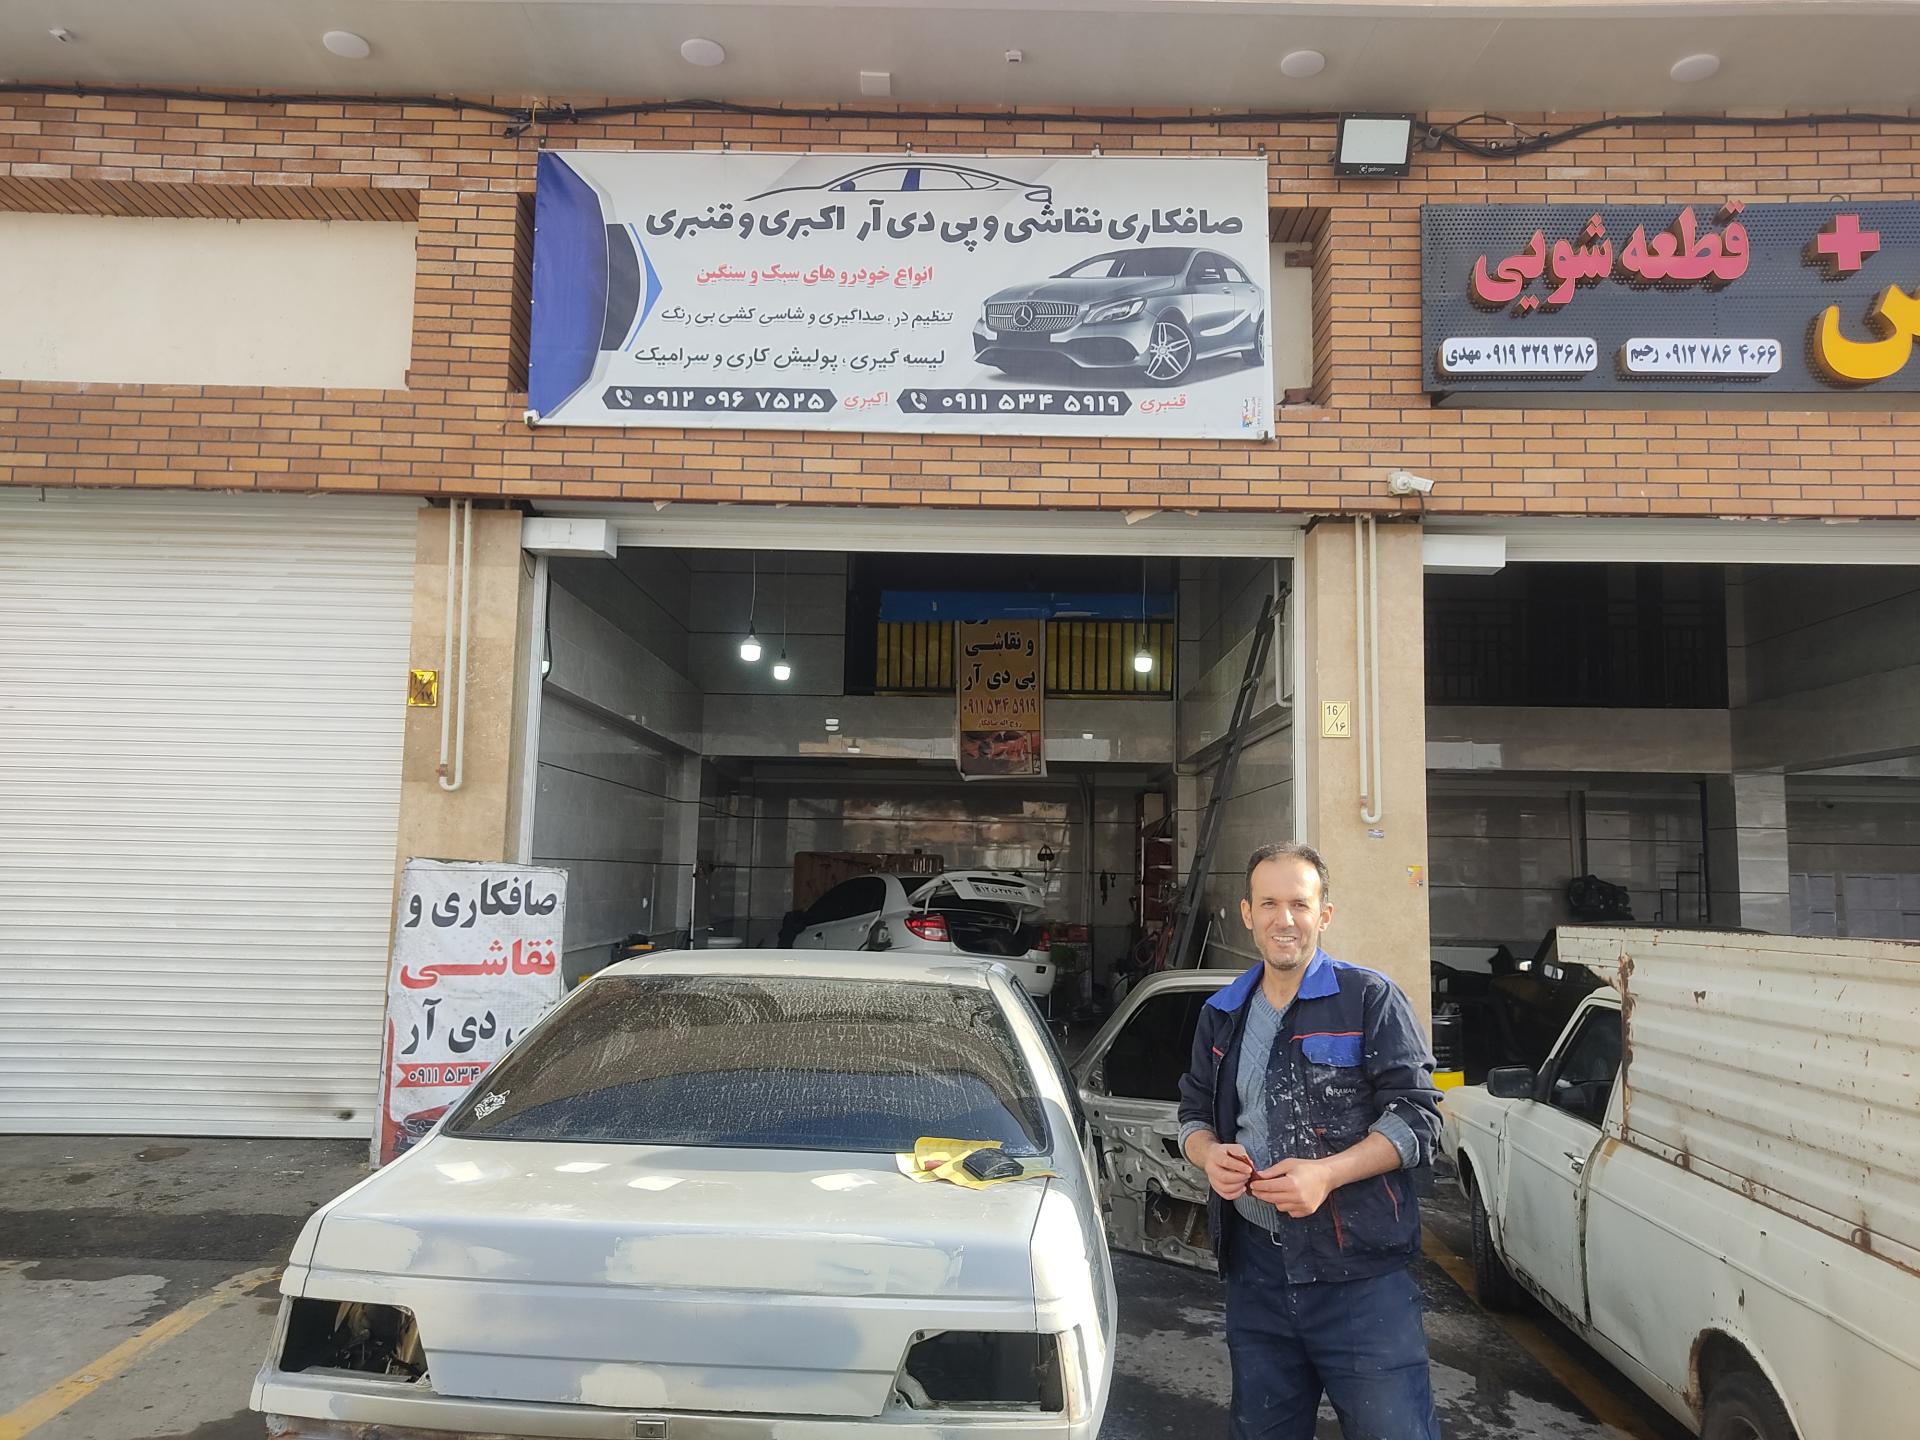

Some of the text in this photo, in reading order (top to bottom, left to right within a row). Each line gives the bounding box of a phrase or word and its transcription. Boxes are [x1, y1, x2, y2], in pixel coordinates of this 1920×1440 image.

[646, 199, 1243, 252] صافکاری نقاشی و پی دی آر اکبری و قنبری
[1475, 200, 1750, 310] قطعه شویی
[695, 263, 933, 287] انواع خودرو های سبک و سنگین
[660, 305, 692, 325] رنگ
[694, 311, 716, 324] بی
[718, 305, 756, 324] کشی
[758, 306, 805, 325] شاسی
[807, 311, 816, 326] و
[818, 308, 885, 327] صداگیری
[911, 308, 953, 328] تنظیم
[634, 346, 710, 369] سرامیک
[712, 352, 723, 369] و
[726, 347, 770, 370] کاری
[773, 346, 838, 372] پولیش
[903, 350, 945, 369] لیسه
[1446, 343, 1595, 367] ۰۹۱۹ ۳۲۹ ۳۶۸۶ مهدی
[1630, 343, 1659, 364] رحیم
[1738, 343, 1777, 365] ۴۰۶۶
[643, 390, 889, 410] اکبری ۰۹۱۲ ۰۹۶ ۷۵۲۵
[942, 392, 1188, 413] قنبری ۰۹۱۱ ۵۳۴ ۵۹۱۹
[965, 631, 1034, 657] و نقاشی
[964, 663, 1037, 690] پی دی آر
[1326, 704, 1339, 716] 16
[1335, 721, 1347, 732] ۱۶
[404, 876, 558, 928] صافکاری و
[400, 938, 556, 989] نقاشی
[400, 998, 442, 1055] آر
[448, 1009, 497, 1054] دی
[409, 1067, 481, 1083] ۰۹۱۱ ۵۳۴
